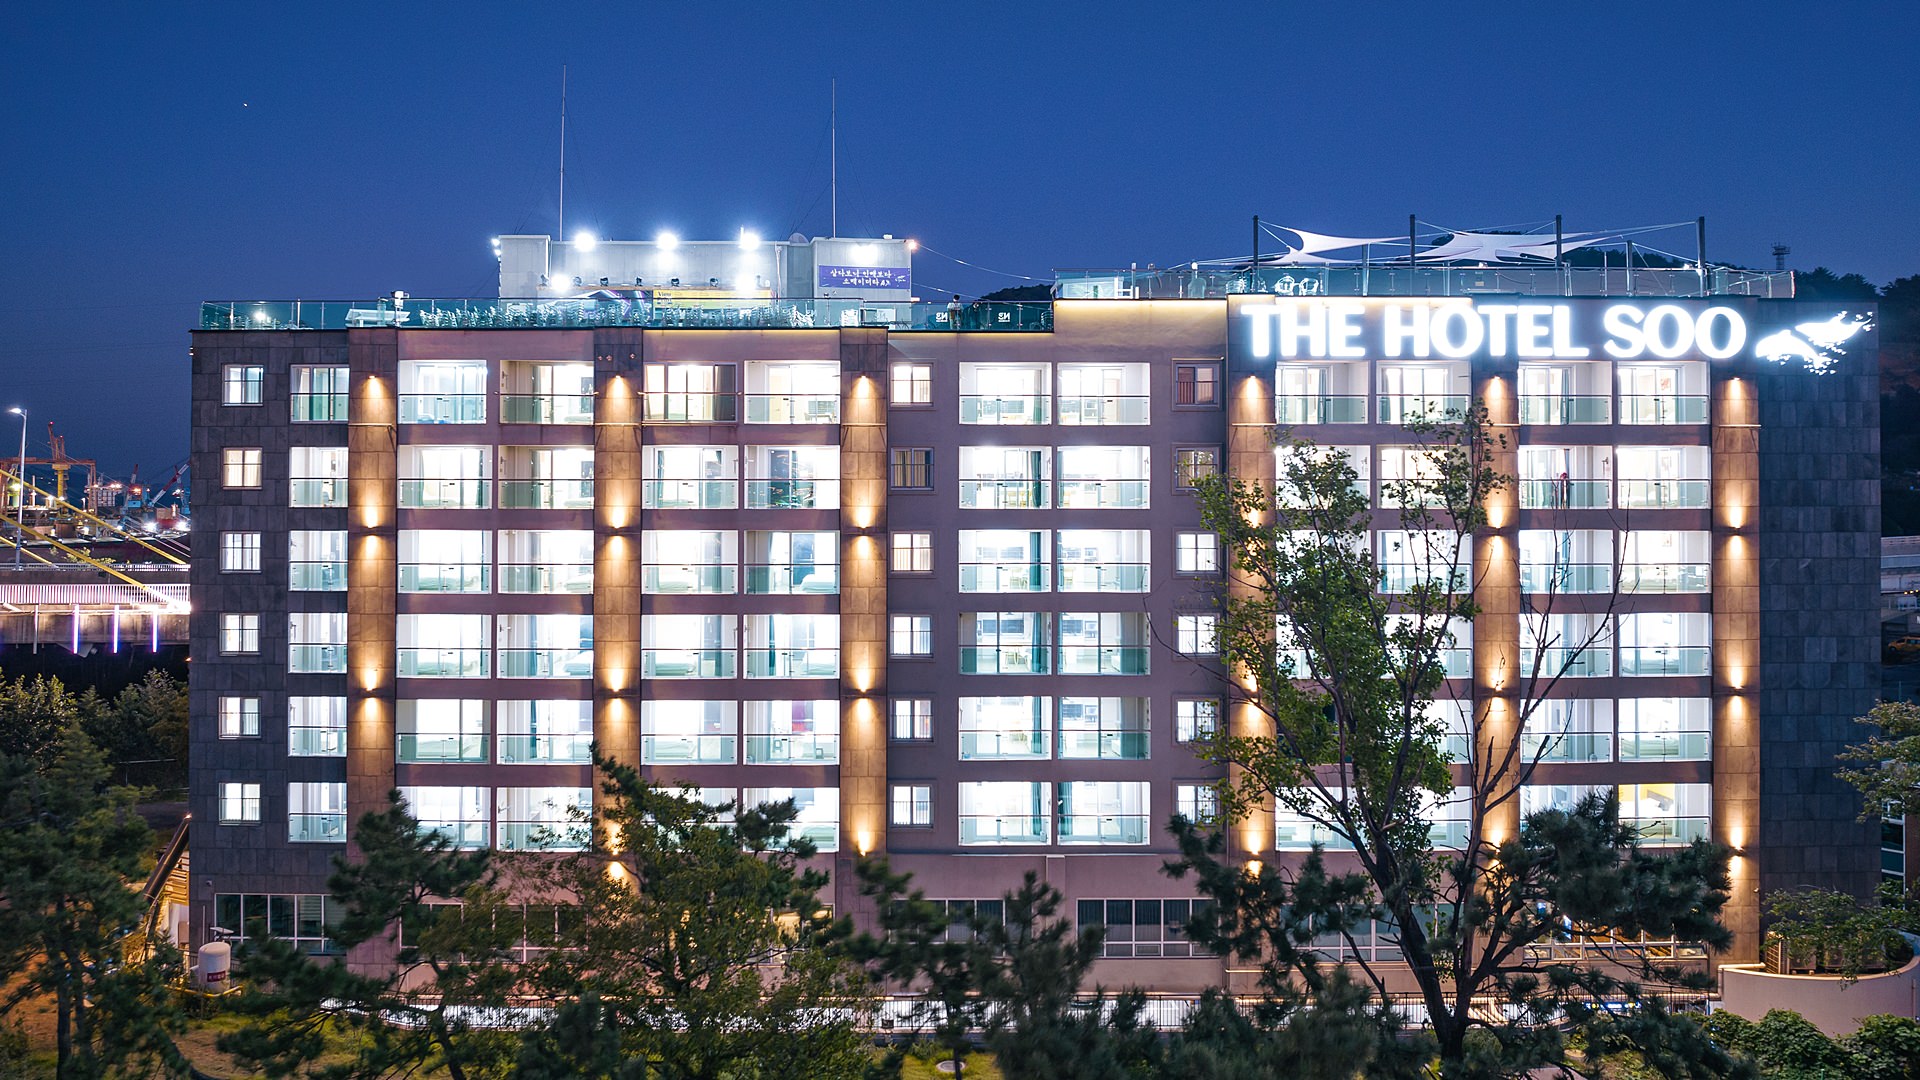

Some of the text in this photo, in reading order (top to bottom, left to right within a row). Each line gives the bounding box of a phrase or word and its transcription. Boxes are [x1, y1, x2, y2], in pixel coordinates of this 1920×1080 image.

[1240, 304, 1747, 359] THE HOTEL SOO
